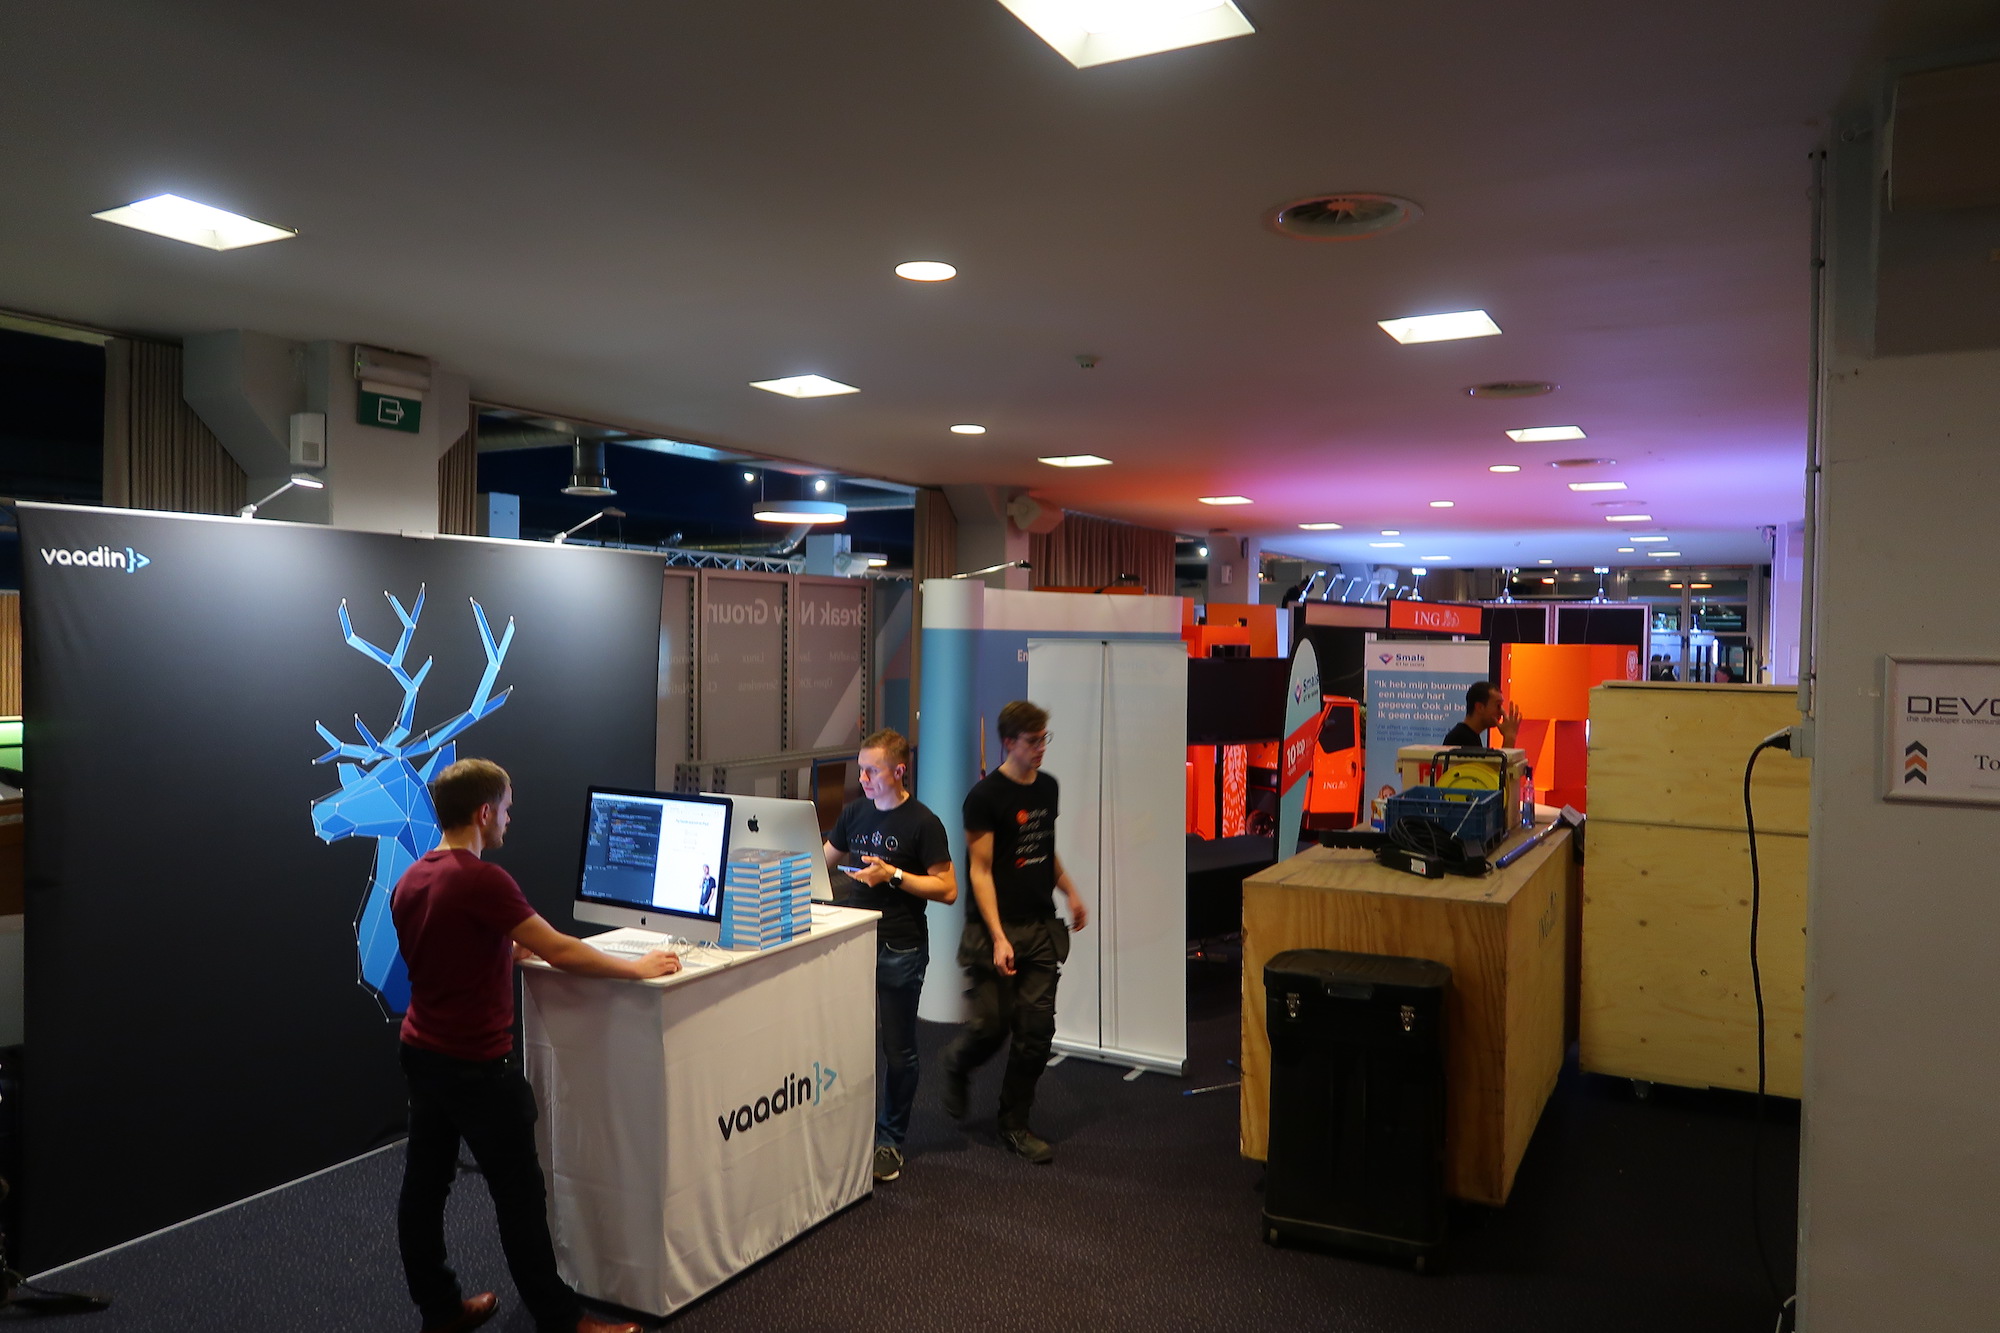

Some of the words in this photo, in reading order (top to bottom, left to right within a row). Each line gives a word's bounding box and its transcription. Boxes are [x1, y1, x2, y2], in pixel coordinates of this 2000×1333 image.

[1413, 610, 1440, 627] ING
[1395, 653, 1425, 662] Smals
[1389, 680, 1407, 689] heb
[1409, 681, 1428, 691] mijn
[1378, 691, 1395, 699] een
[1397, 691, 1424, 700] nieuw
[1427, 691, 1446, 701] hart
[1378, 701, 1419, 711] gegeven.
[1422, 702, 1441, 710] Ook
[1443, 702, 1452, 711] al
[1388, 711, 1411, 721] geen
[1921, 716, 1960, 725] developer
[1323, 781, 1338, 790] ING
